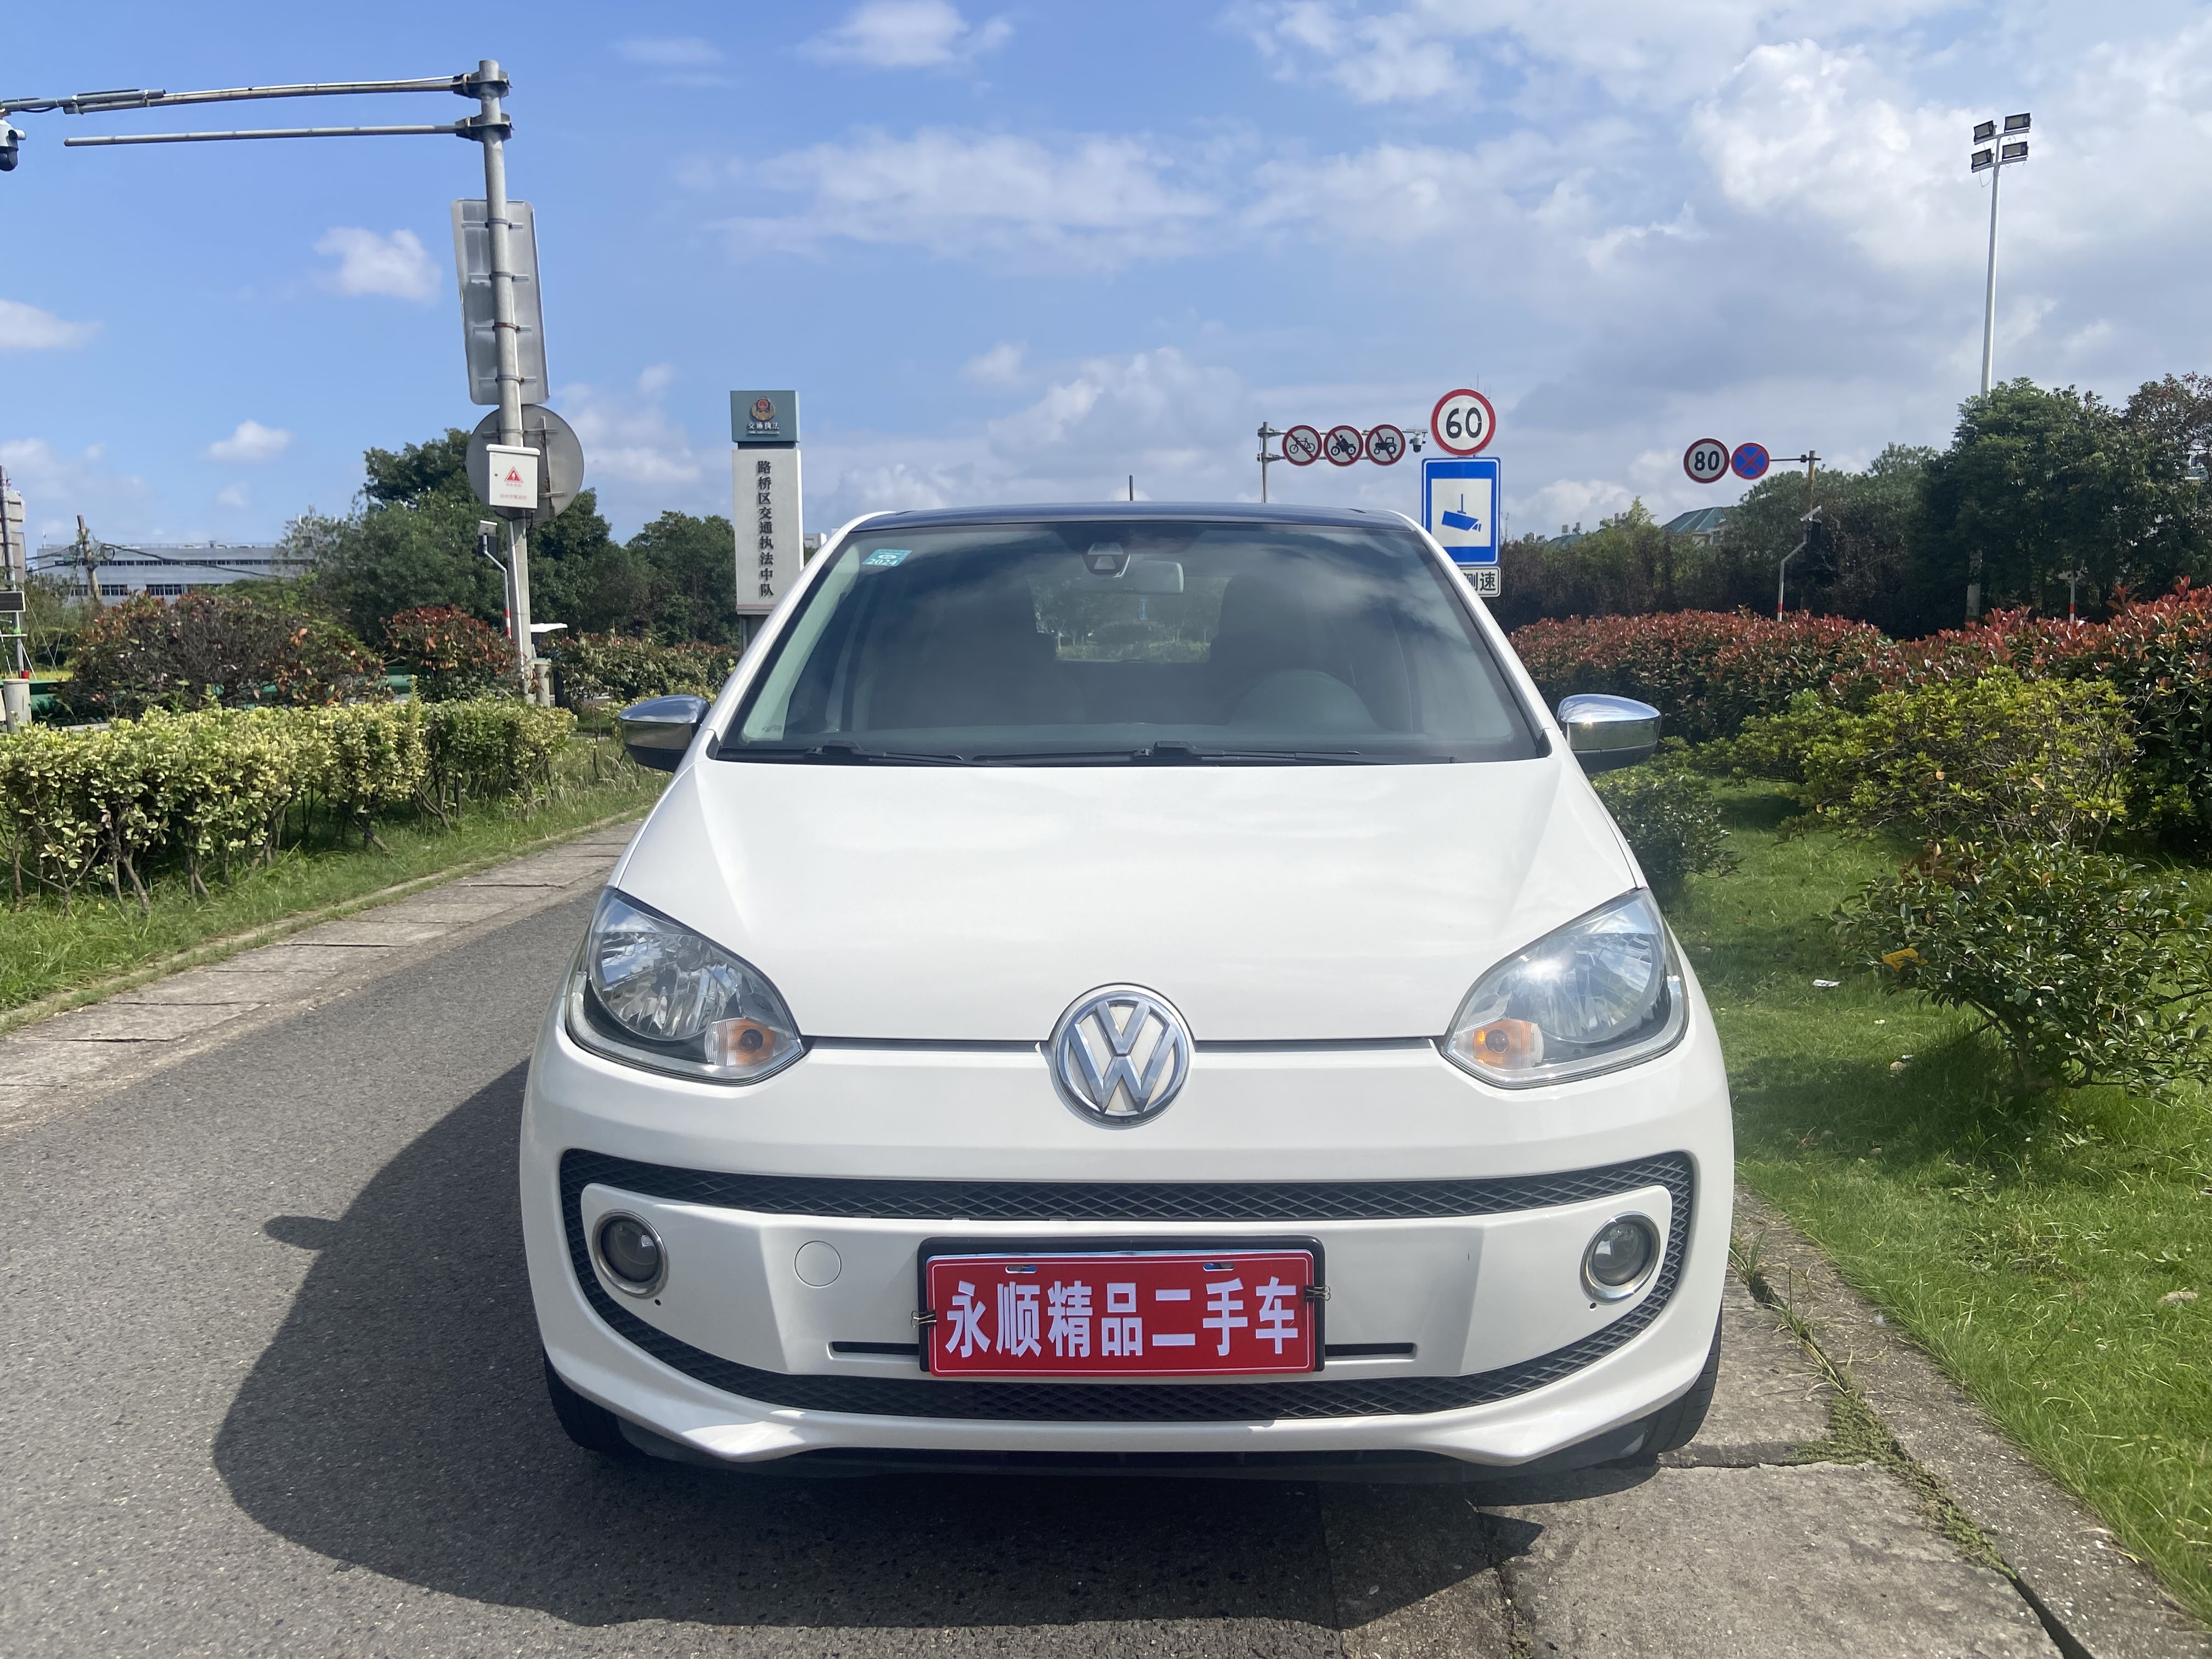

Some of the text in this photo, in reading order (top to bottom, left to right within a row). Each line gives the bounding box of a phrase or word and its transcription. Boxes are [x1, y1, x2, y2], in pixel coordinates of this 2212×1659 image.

[1446, 407, 1482, 439] 60
[1694, 450, 1719, 471] 80
[757, 460, 774, 597] 路桥区交通执法中队
[1063, 998, 1180, 1116] VW
[945, 1276, 1299, 1358] 永顺精品二手车
